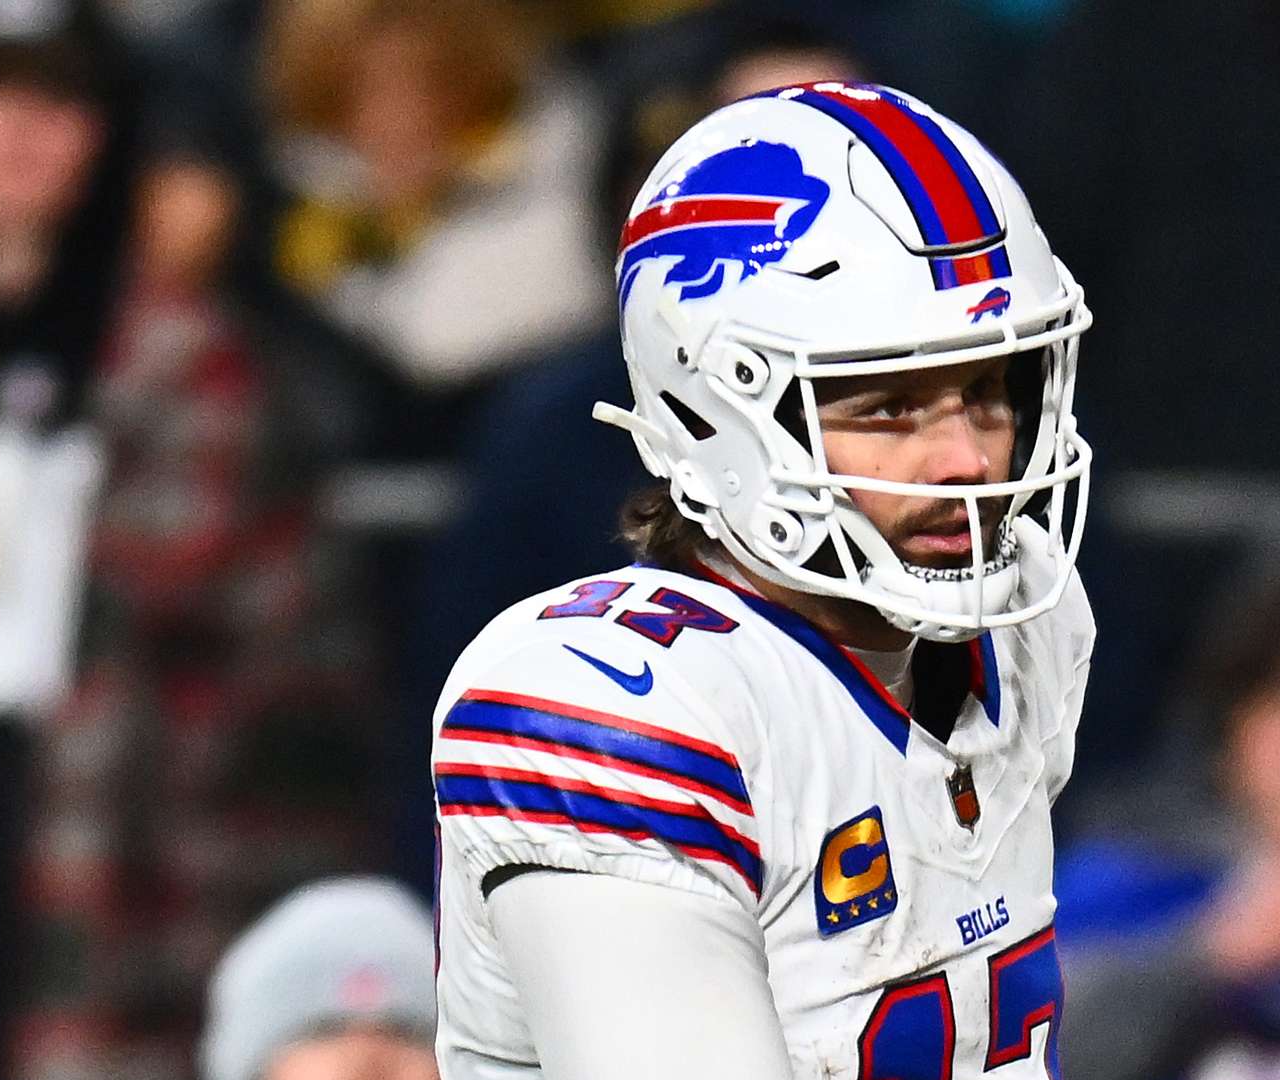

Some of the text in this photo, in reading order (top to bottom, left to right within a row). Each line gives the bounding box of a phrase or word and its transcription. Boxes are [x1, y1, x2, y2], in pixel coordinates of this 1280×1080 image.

[536, 578, 741, 649] 17
[822, 817, 889, 904] C
[956, 895, 1010, 946] BILLS
